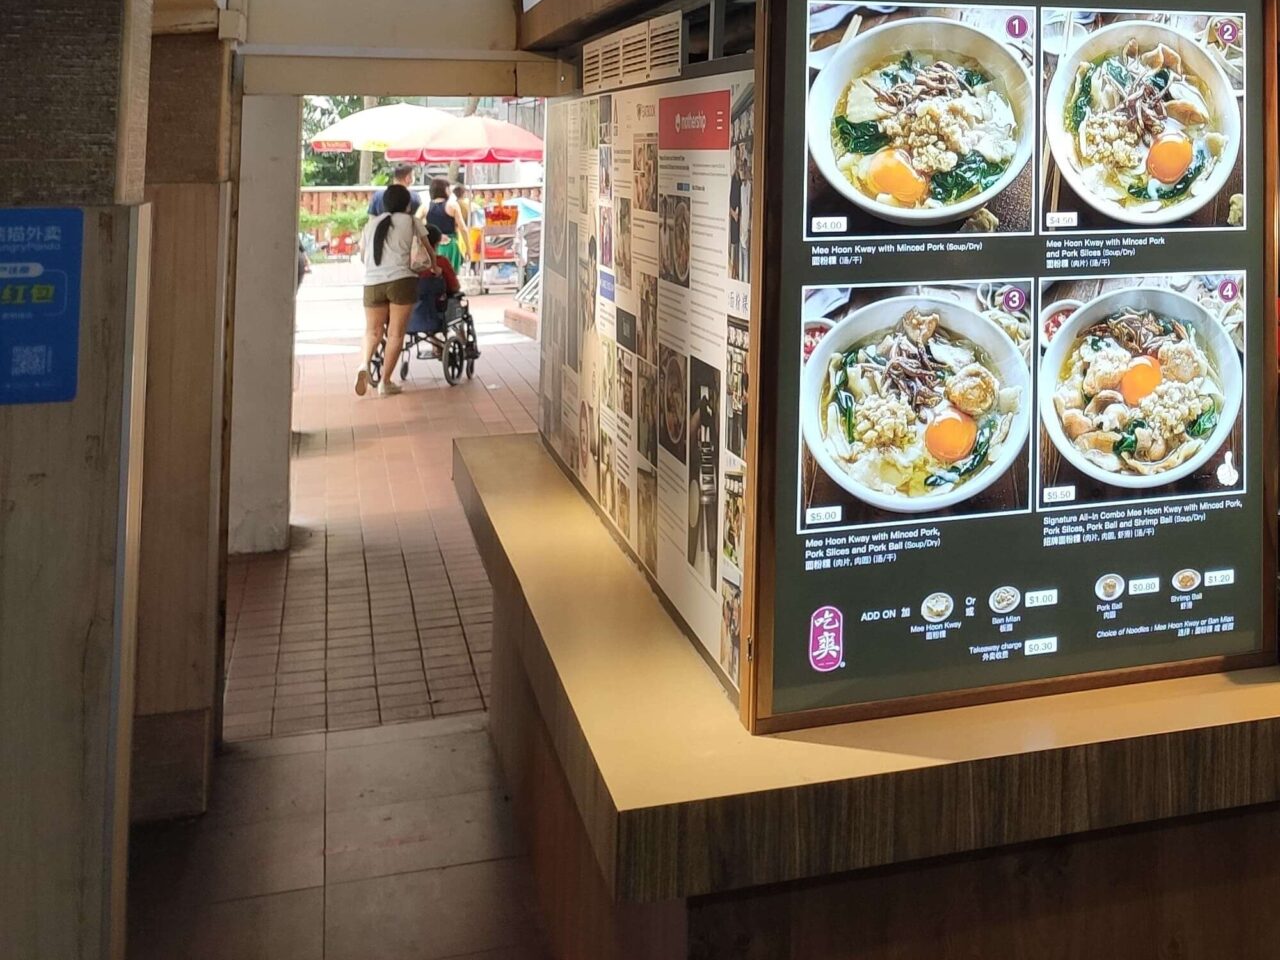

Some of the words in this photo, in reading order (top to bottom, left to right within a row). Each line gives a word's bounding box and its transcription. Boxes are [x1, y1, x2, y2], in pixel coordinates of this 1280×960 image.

[1012, 21, 1021, 34] 1
[1223, 24, 1232, 38] 2
[681, 111, 706, 133] mothership
[816, 220, 842, 230] $4.00
[1046, 239, 1062, 247] Mee
[1064, 239, 1083, 247] Hoon
[1085, 238, 1104, 247] Kway
[1106, 237, 1120, 246] with
[1122, 237, 1147, 246] Minced
[1149, 236, 1165, 245] Pork
[812, 246, 829, 254] Mee
[832, 245, 852, 253] Hoon
[855, 245, 876, 254] Kway
[878, 244, 894, 252] with
[897, 243, 925, 252] Minced
[927, 242, 944, 251] Pork
[946, 242, 983, 251] (Soup/Dry)
[1046, 249, 1060, 258] and
[1062, 249, 1078, 257] Pork
[1080, 248, 1101, 257] Slices
[1103, 248, 1135, 257] (Soup/Dry)
[1222, 284, 1234, 298] 4
[1009, 292, 1020, 307] 3
[810, 511, 837, 521] $5.00
[1043, 515, 1077, 526] Signature
[1100, 510, 1125, 520] Combo
[1127, 509, 1142, 518] Mee
[1144, 506, 1162, 515] Hoon
[1164, 504, 1182, 514] Kway
[1184, 502, 1198, 511] with
[1199, 500, 1224, 510] Minced
[1225, 499, 1242, 508] Pork,
[1043, 526, 1060, 535] Pork
[1061, 524, 1085, 534] Slices,
[1087, 522, 1103, 531] Pork
[1104, 520, 1118, 529] Ball
[1119, 519, 1132, 528] and
[1134, 516, 1158, 527] Shrimp
[1160, 515, 1173, 524] Ball
[1174, 513, 1206, 523] (Soup/Dry)
[806, 538, 823, 548] Mee
[825, 537, 846, 546] Hoon
[848, 535, 870, 544] Kway
[872, 532, 888, 541] with
[890, 530, 918, 540] Minced
[920, 527, 940, 538] Pork,
[806, 549, 824, 559] Pork
[826, 547, 849, 556] Slices
[852, 545, 866, 554] and
[869, 543, 887, 552] Pork
[888, 541, 903, 550] Ball
[905, 538, 940, 550] (Soup/Dry)
[1207, 573, 1230, 584] $1.20
[1132, 581, 1156, 592] $0.80
[965, 596, 976, 606] Or
[1029, 594, 1053, 605] $1.00
[1096, 603, 1110, 612] Pork
[860, 611, 881, 622] ADD
[882, 609, 896, 619] ON
[910, 624, 925, 633] Mee
[926, 622, 943, 631] Hoon
[944, 620, 962, 630] Kway
[813, 610, 840, 660] 吃爽
[1096, 628, 1117, 639] Choice
[1118, 627, 1125, 636] of
[1028, 641, 1053, 653] $0.30
